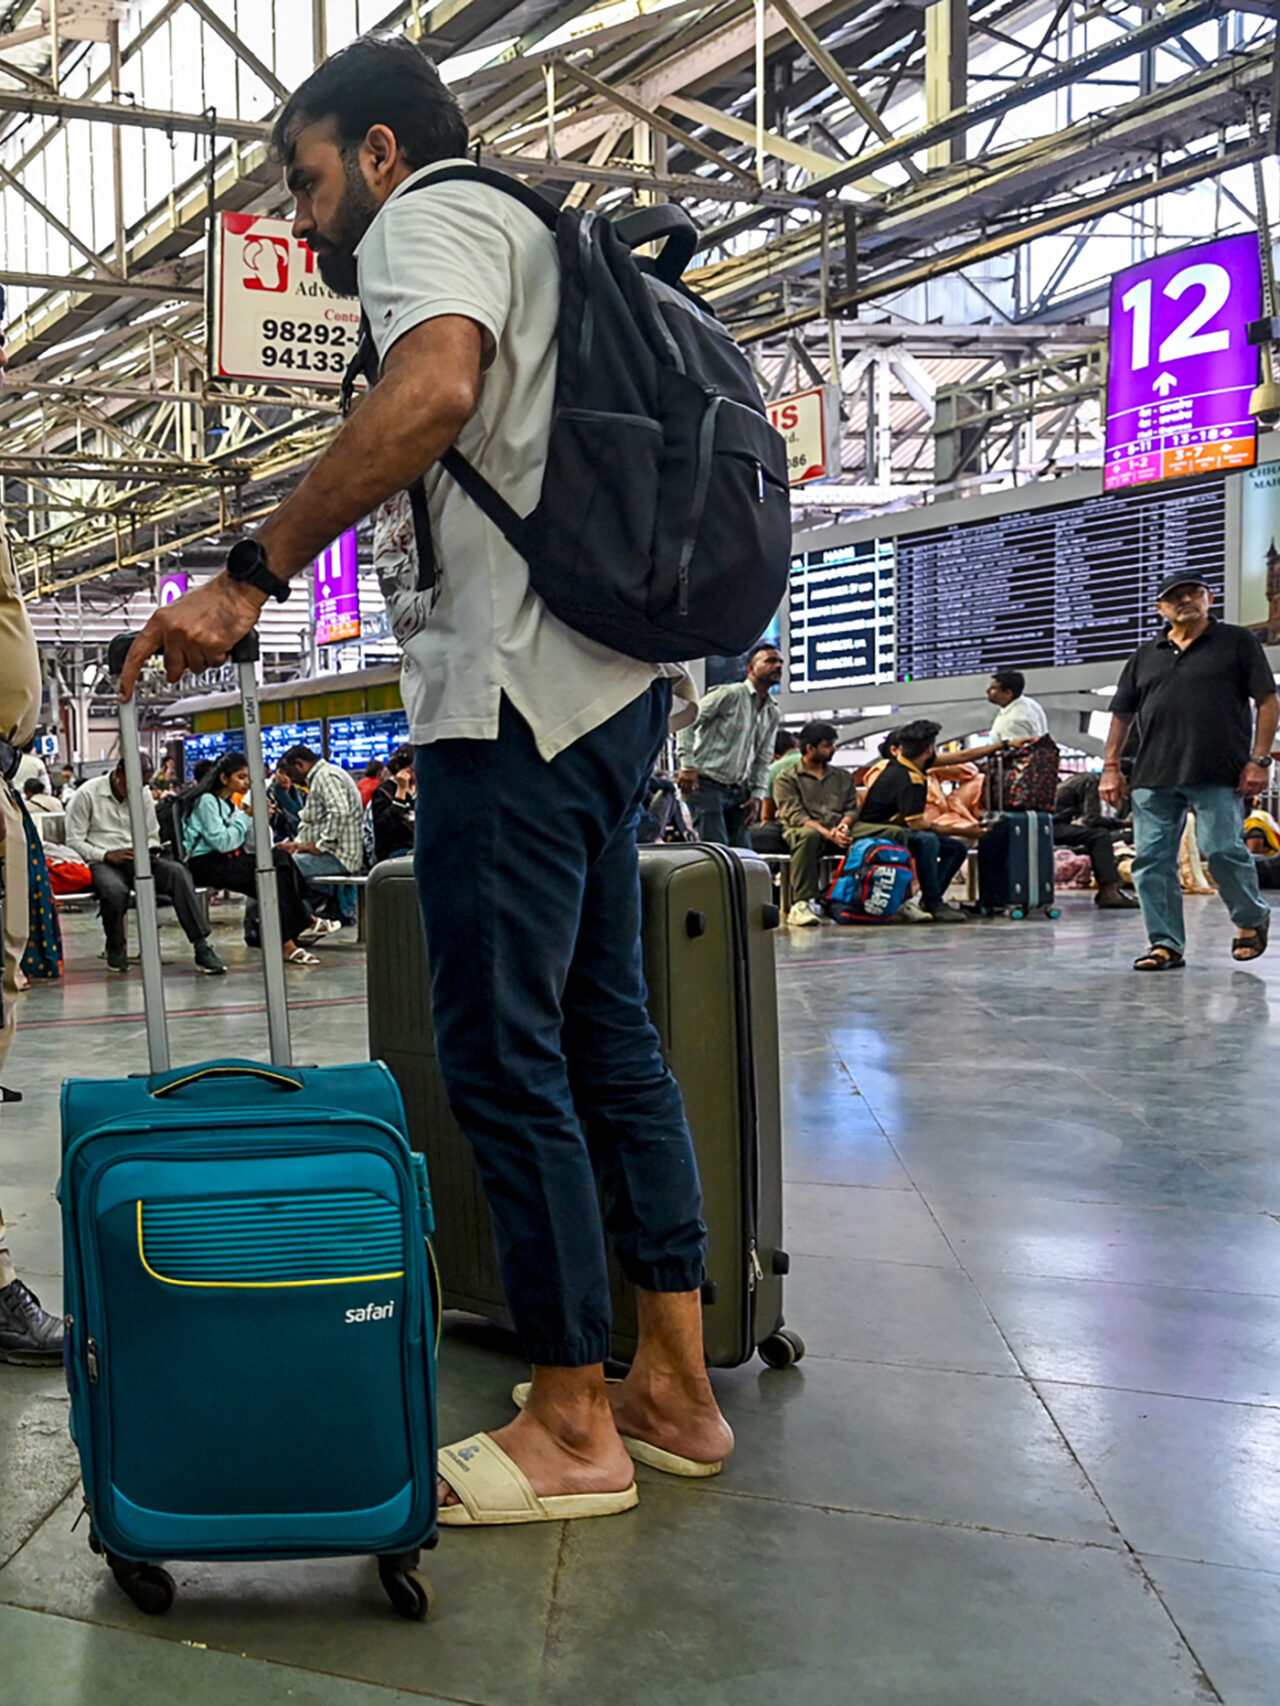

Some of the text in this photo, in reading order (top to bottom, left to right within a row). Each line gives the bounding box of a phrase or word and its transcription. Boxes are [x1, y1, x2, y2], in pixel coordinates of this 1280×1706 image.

[1122, 263, 1231, 371] 12
[262, 319, 358, 347] 98292-
[345, 1300, 394, 1323] safari
